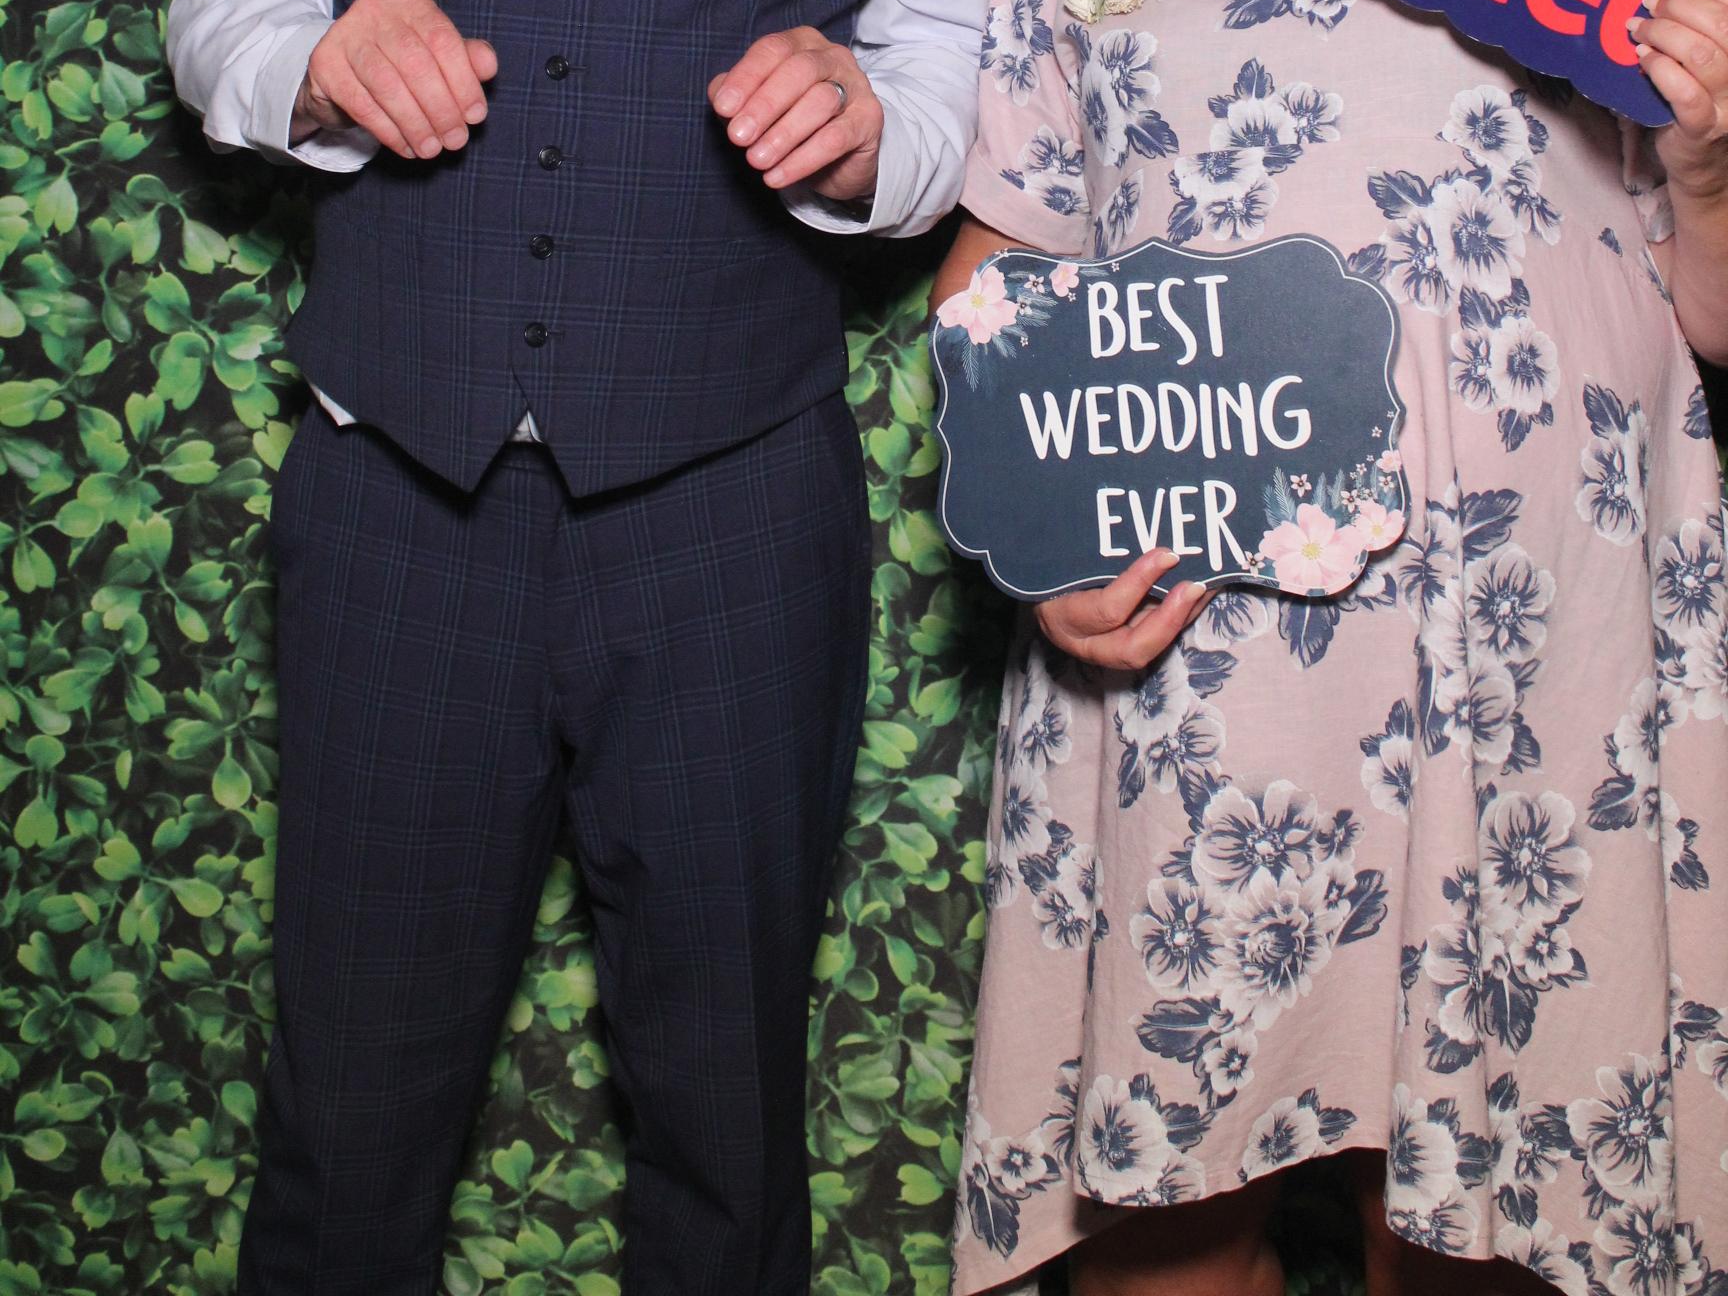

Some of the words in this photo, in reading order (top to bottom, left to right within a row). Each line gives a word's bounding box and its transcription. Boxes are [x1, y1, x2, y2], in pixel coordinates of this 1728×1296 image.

[1087, 275, 1229, 366] BEST
[1019, 375, 1312, 460] WEDDING
[1096, 480, 1248, 572] EVER
